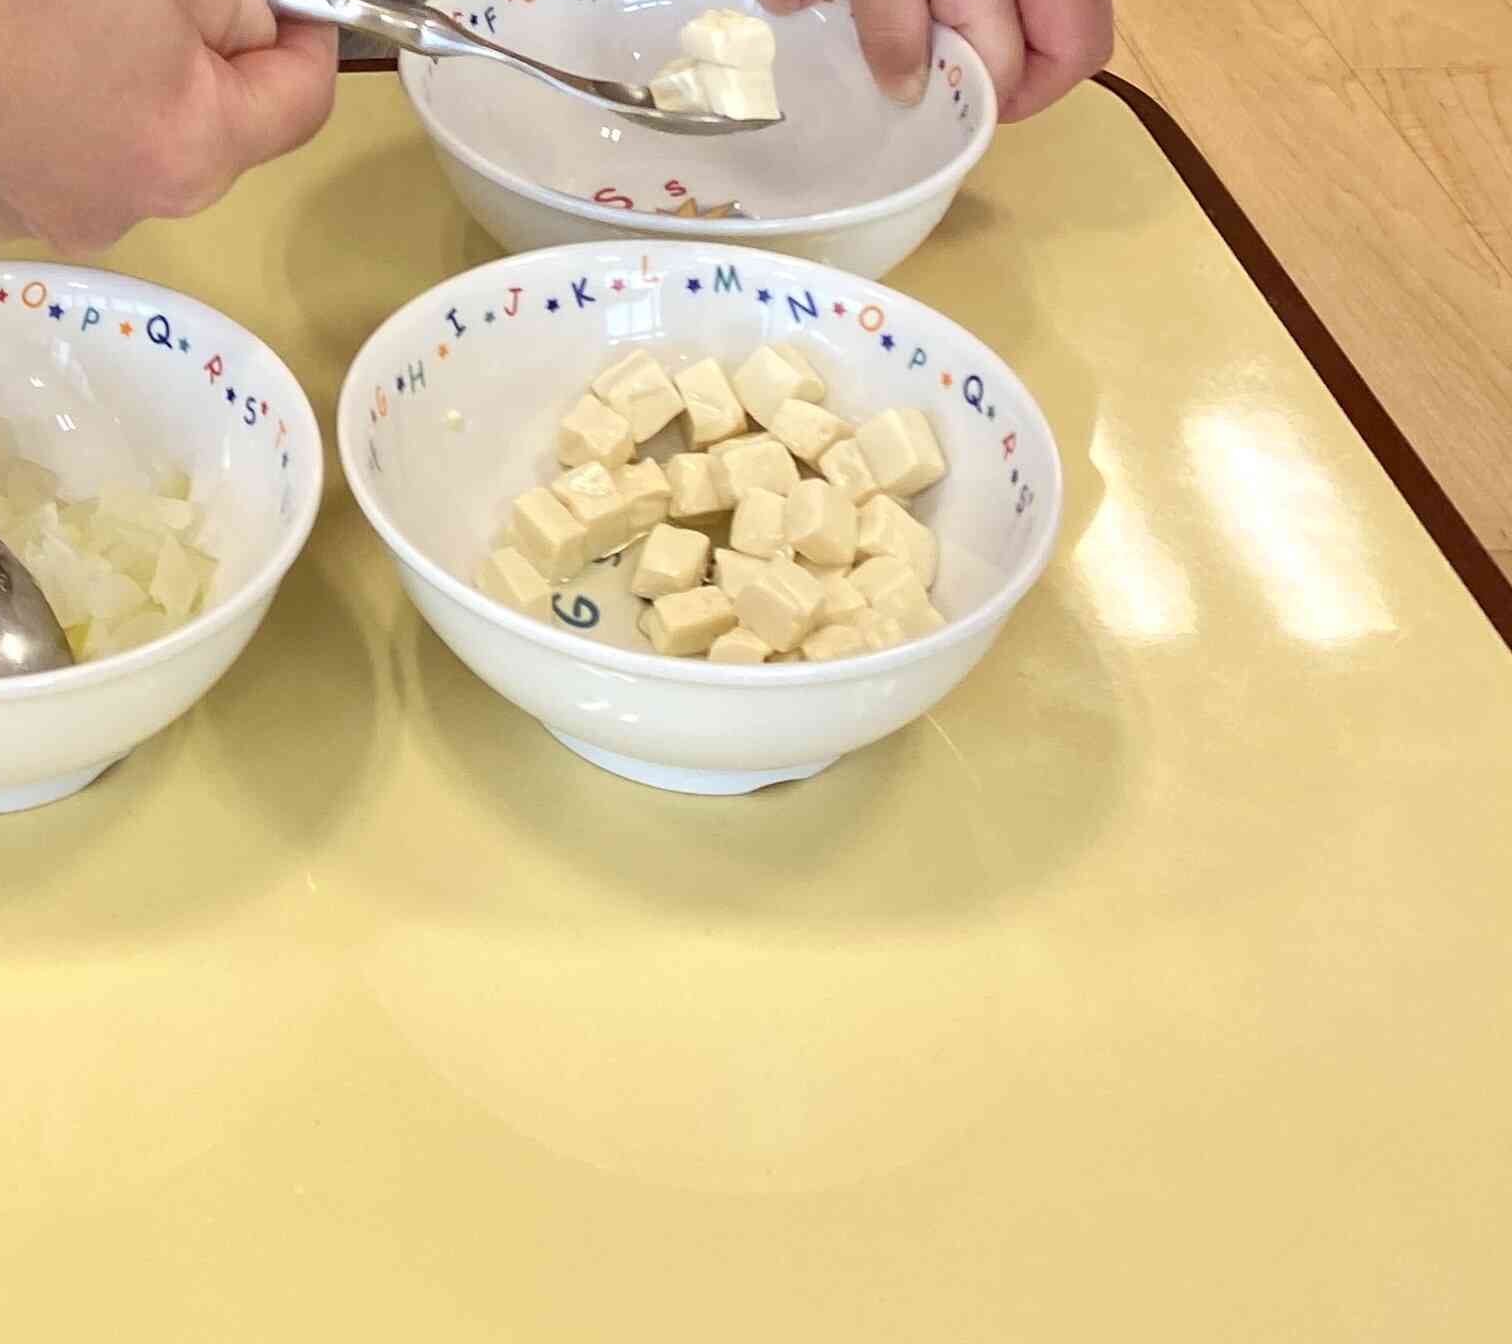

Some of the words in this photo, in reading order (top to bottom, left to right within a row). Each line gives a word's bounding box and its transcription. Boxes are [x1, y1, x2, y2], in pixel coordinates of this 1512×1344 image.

[21, 281, 47, 309] O
[146, 314, 173, 349] Q
[203, 354, 223, 384] R
[243, 396, 257, 426] S
[408, 360, 426, 393] H
[446, 308, 467, 339] I
[504, 288, 524, 317] J
[571, 277, 596, 309] K
[641, 255, 660, 282] L
[713, 265, 743, 294] M
[786, 290, 820, 323] N
[858, 305, 884, 333] O
[963, 375, 984, 414] Q
